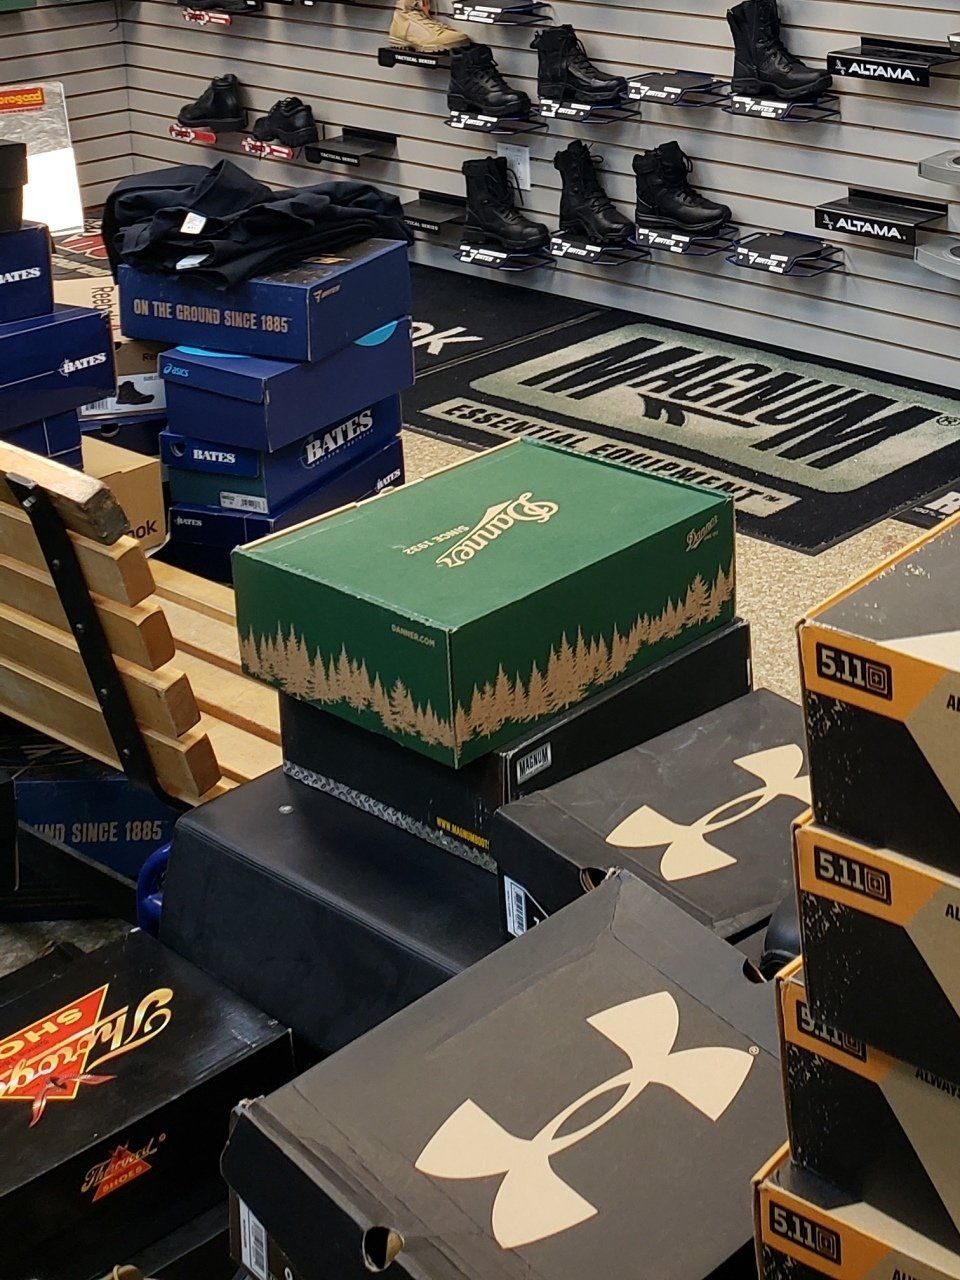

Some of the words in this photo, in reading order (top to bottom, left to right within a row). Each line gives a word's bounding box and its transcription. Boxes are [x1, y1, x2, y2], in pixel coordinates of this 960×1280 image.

[847, 62, 916, 82] ALTAMA
[836, 217, 902, 239] ALTAMA
[133, 299, 149, 315] ON
[152, 300, 173, 319] THE
[176, 303, 221, 325] GROUND
[224, 310, 258, 330] SINCE
[261, 314, 288, 333] 1885
[63, 353, 106, 373] BATES
[171, 366, 189, 378] asics
[518, 337, 938, 471] MAGNUM
[305, 409, 373, 465] BATES
[442, 404, 590, 451] ESSENTIAL
[193, 449, 236, 464] BATES
[587, 442, 767, 503] EQUIPMENT
[432, 524, 471, 544] SINCE
[436, 491, 559, 568] Danner
[403, 539, 435, 556] 1932
[391, 623, 436, 648] DANNER.COM
[820, 647, 866, 686] 5.11
[519, 745, 550, 776] MAGNUM
[70, 821, 118, 843] SINCE
[124, 819, 163, 841] 1885
[818, 850, 866, 892] 5.11
[0, 1008, 83, 1061] SHO
[102, 1164, 143, 1192] SHOES
[773, 1206, 816, 1251] 5.11
